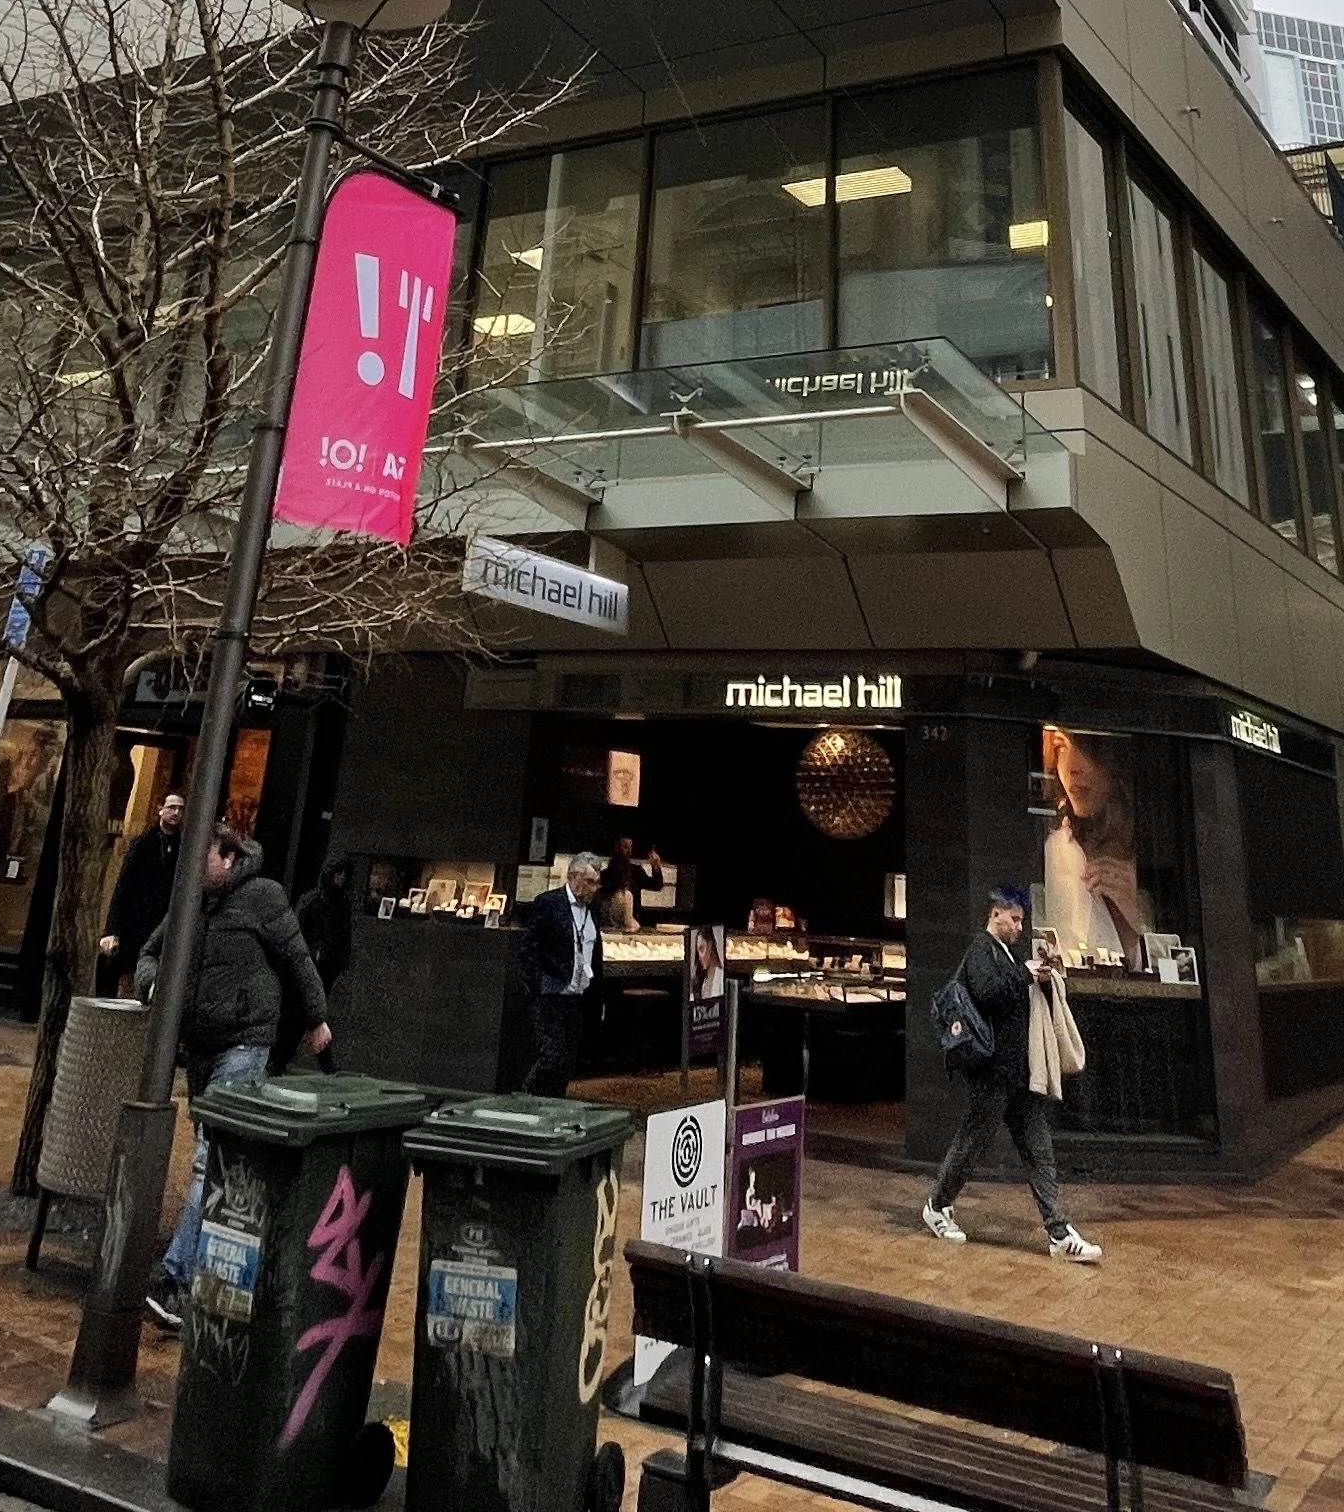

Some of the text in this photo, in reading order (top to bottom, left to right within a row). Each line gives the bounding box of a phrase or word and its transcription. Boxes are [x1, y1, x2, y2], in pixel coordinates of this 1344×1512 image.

[483, 558, 619, 622] michael hill
[724, 674, 903, 709] michael hill
[922, 725, 948, 741] 342
[650, 1184, 718, 1222] THE VAULT
[443, 1274, 503, 1300] GENERAL
